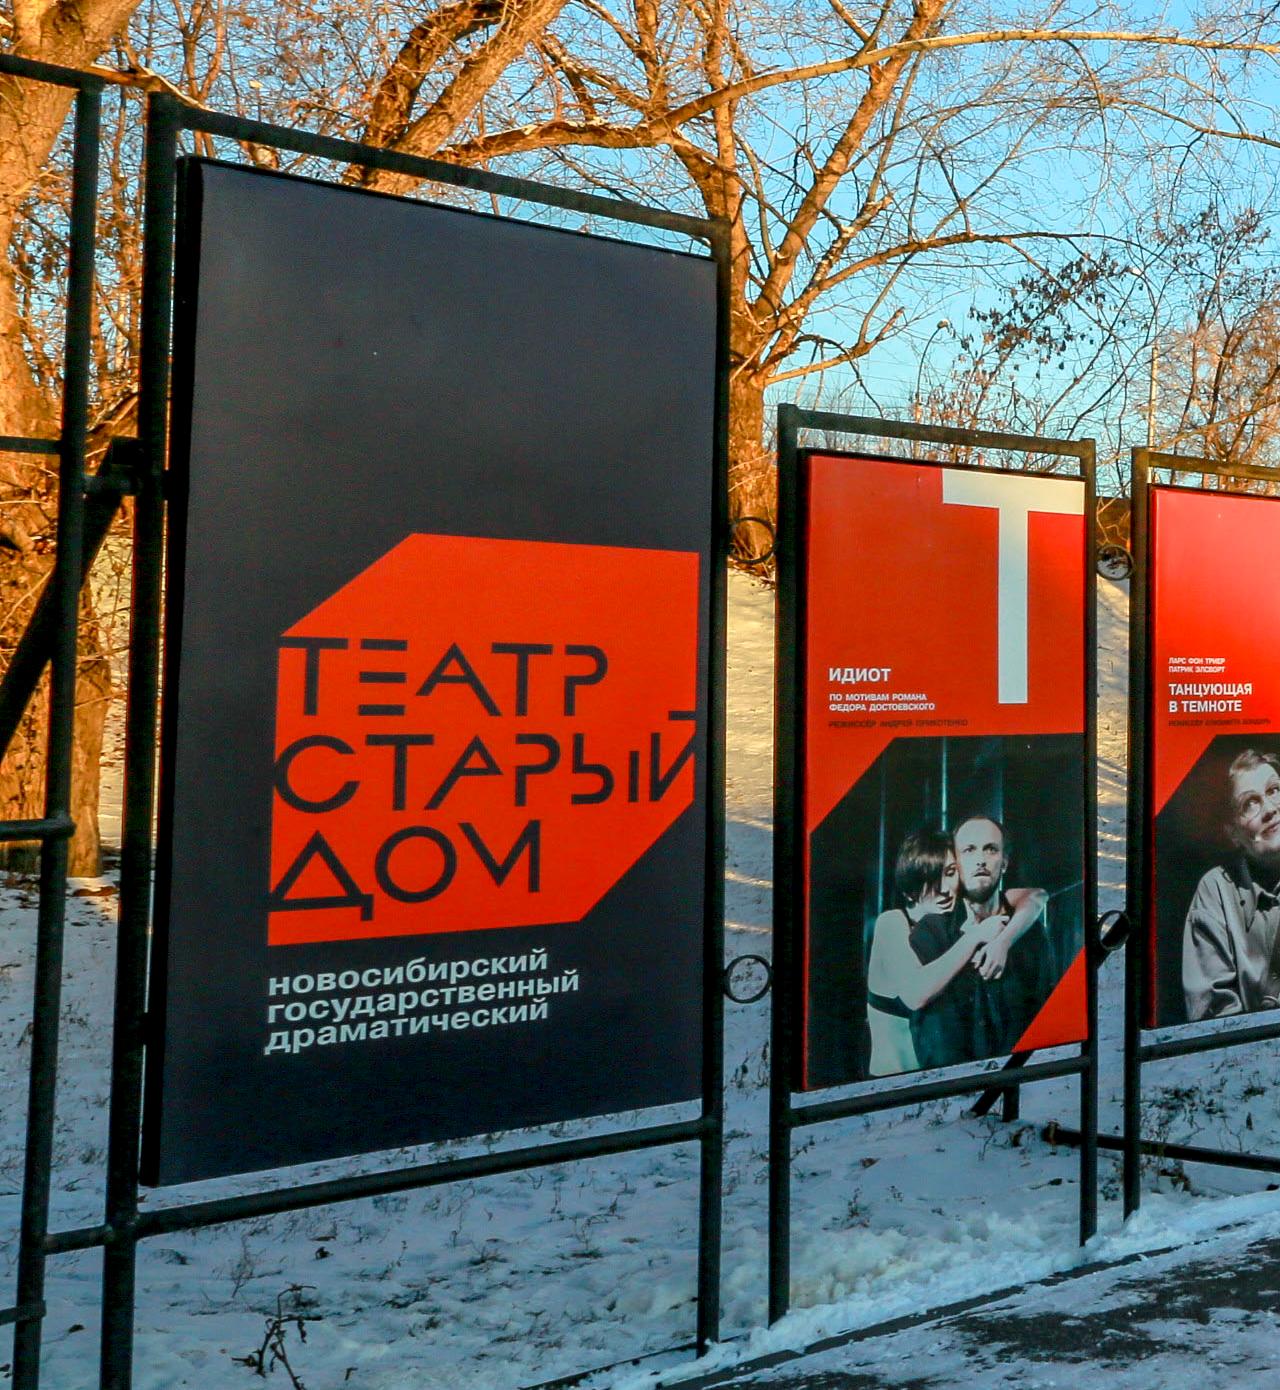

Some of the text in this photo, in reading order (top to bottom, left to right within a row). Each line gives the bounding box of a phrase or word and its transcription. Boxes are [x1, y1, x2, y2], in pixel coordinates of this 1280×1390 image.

[279, 636, 608, 717] ТЕАТР
[828, 667, 891, 684] ИДИОТ
[829, 692, 927, 701] ПО МОТИВАМ РОМАНА
[1168, 683, 1252, 697] ТАНЦУЮЩАЯ
[869, 702, 935, 711] ДОСТОЕВСКОГО
[1169, 700, 1242, 713] В ТЕМНОТЕ
[273, 711, 697, 814] СТАРЫЙ
[268, 819, 541, 921] ДОМ
[267, 969, 579, 1023] государственный
[268, 947, 548, 996] новосибирский
[263, 997, 549, 1055] драматический
